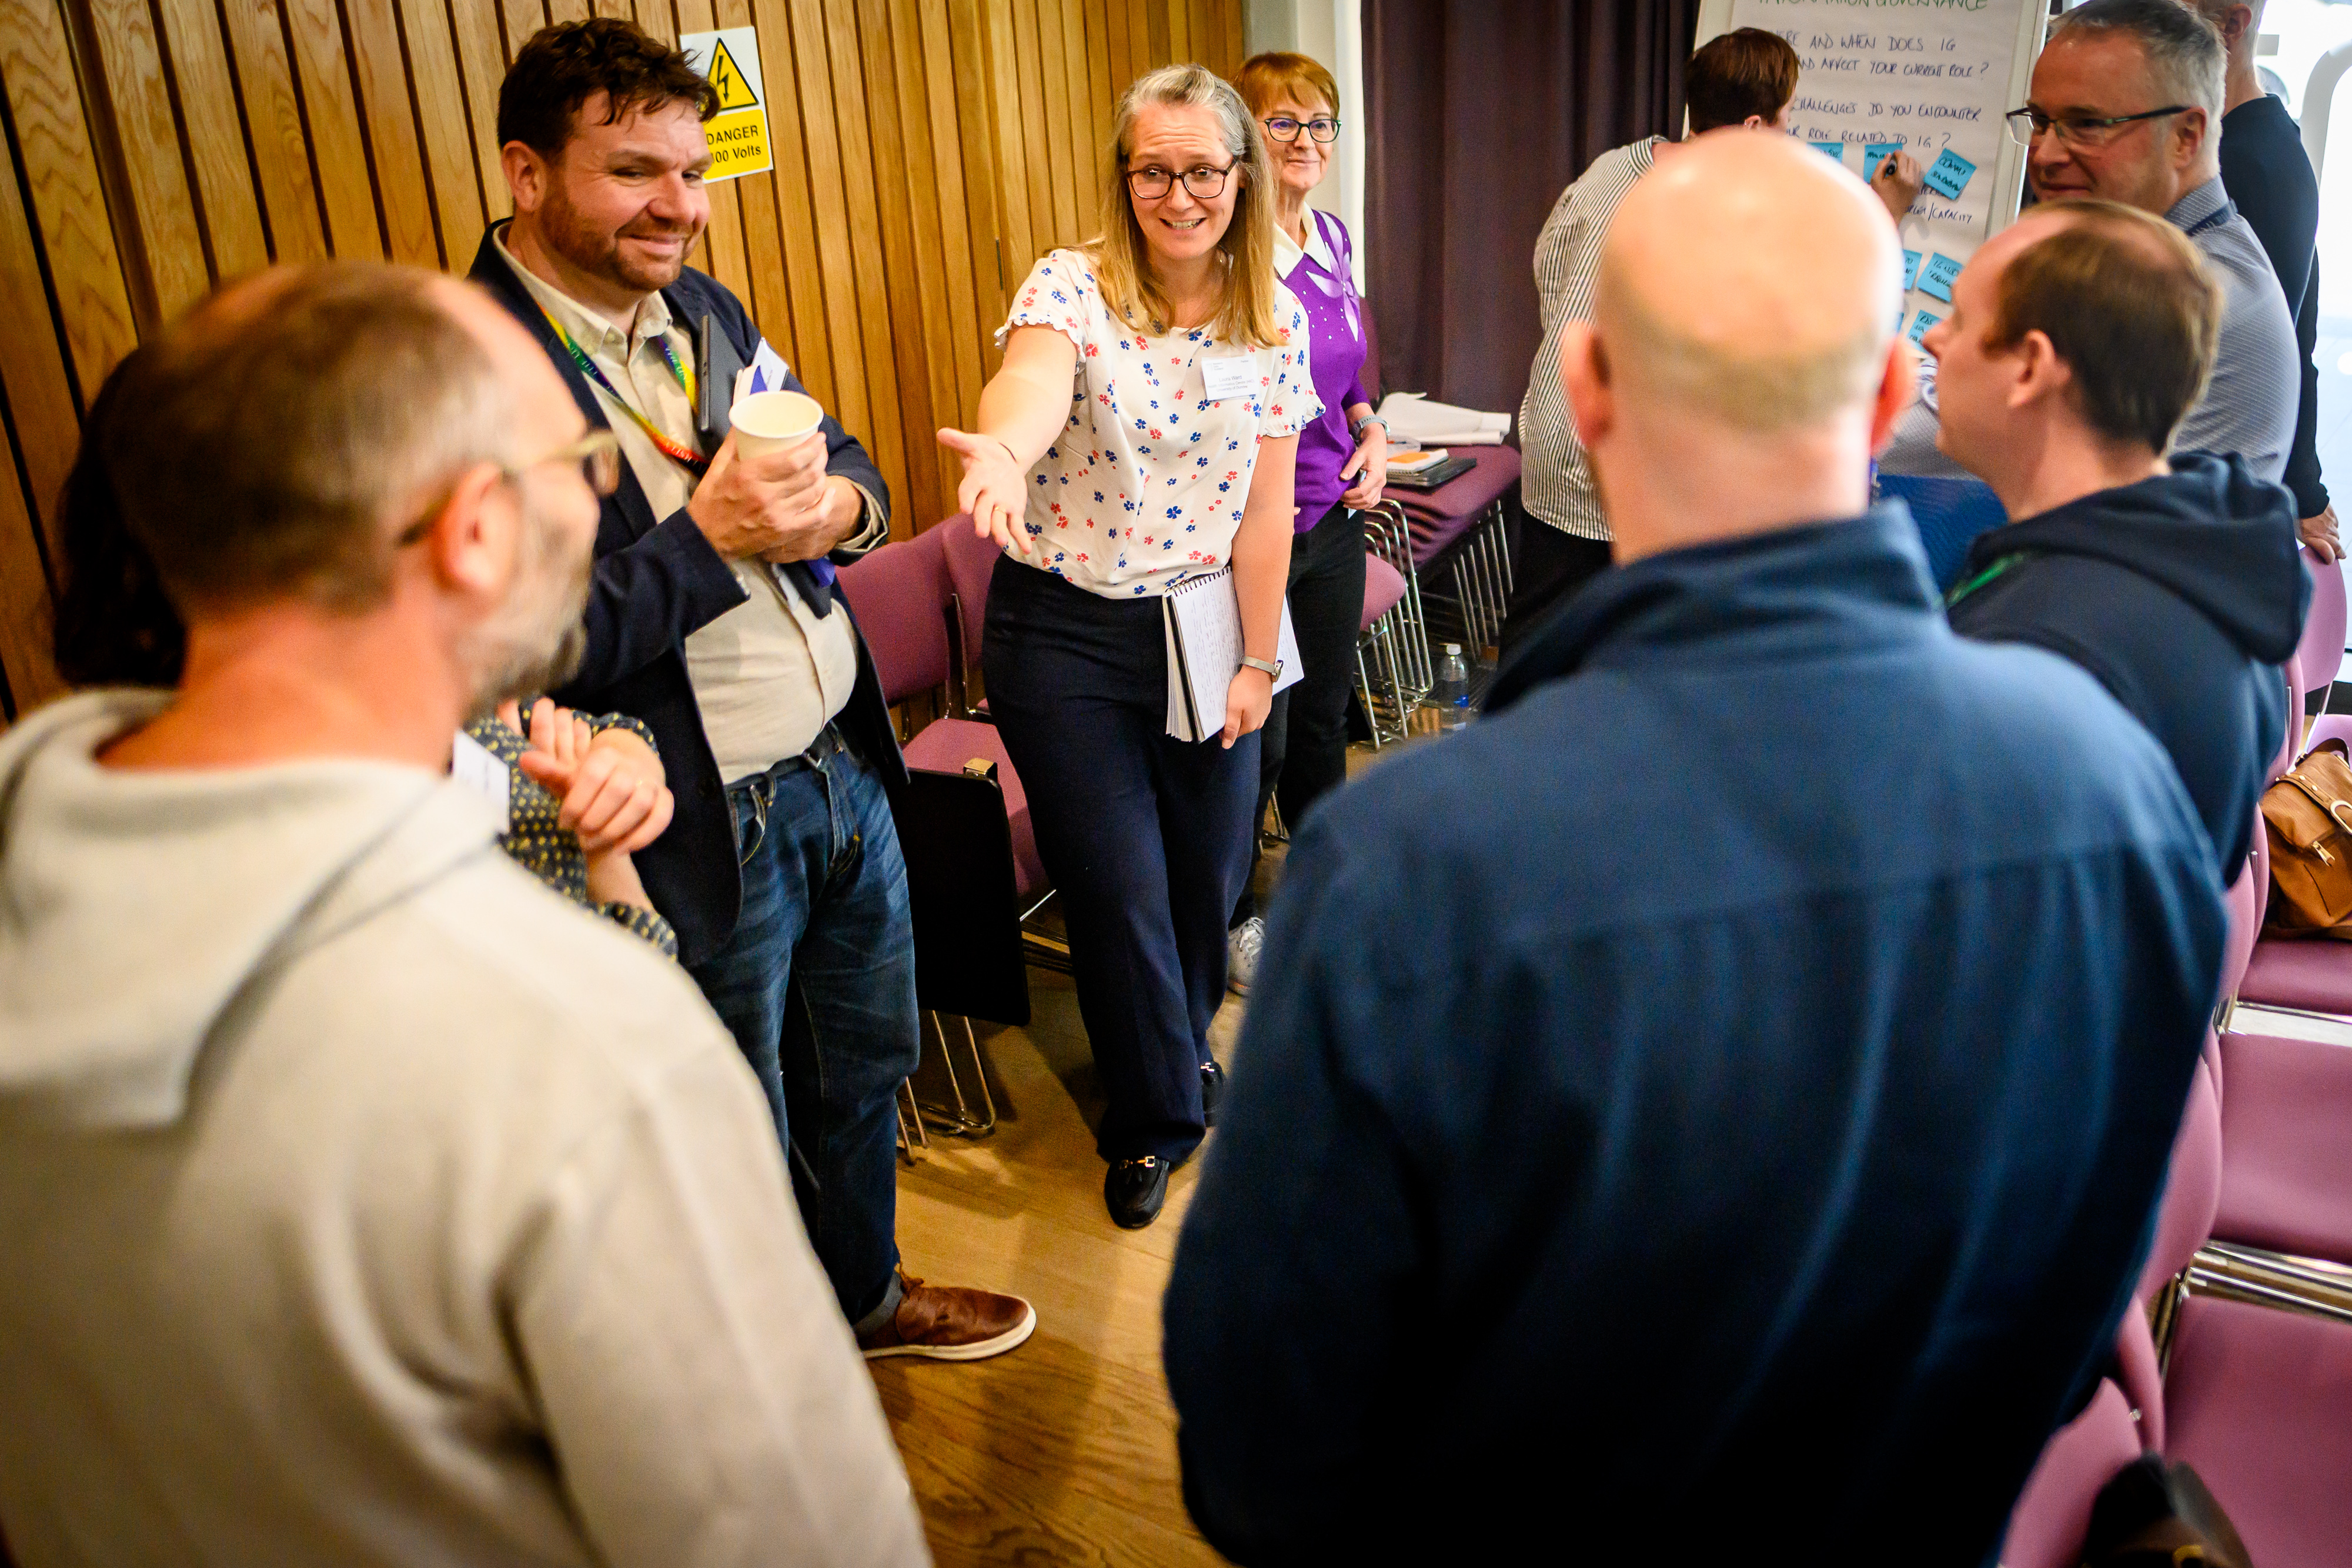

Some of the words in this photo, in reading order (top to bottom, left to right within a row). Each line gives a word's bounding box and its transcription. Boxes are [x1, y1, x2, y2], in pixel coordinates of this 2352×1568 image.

[1810, 33, 1833, 49] AND
[1841, 34, 1876, 49] WHEN
[1888, 36, 1923, 51] DOES
[1870, 61, 1897, 75] YOUR
[1903, 63, 1946, 77] CURRENT
[1949, 63, 1973, 77] ROLE
[1793, 98, 1858, 115] CHALLENGES
[1869, 102, 1883, 116] DO
[1891, 103, 1912, 118] YOU
[1918, 104, 1982, 121] ENCOUNTER
[706, 125, 759, 145] DANGER
[1808, 127, 1832, 140] ROLE
[1842, 129, 1886, 144] RELATED
[711, 150, 729, 163] 00
[733, 145, 761, 159] Volts
